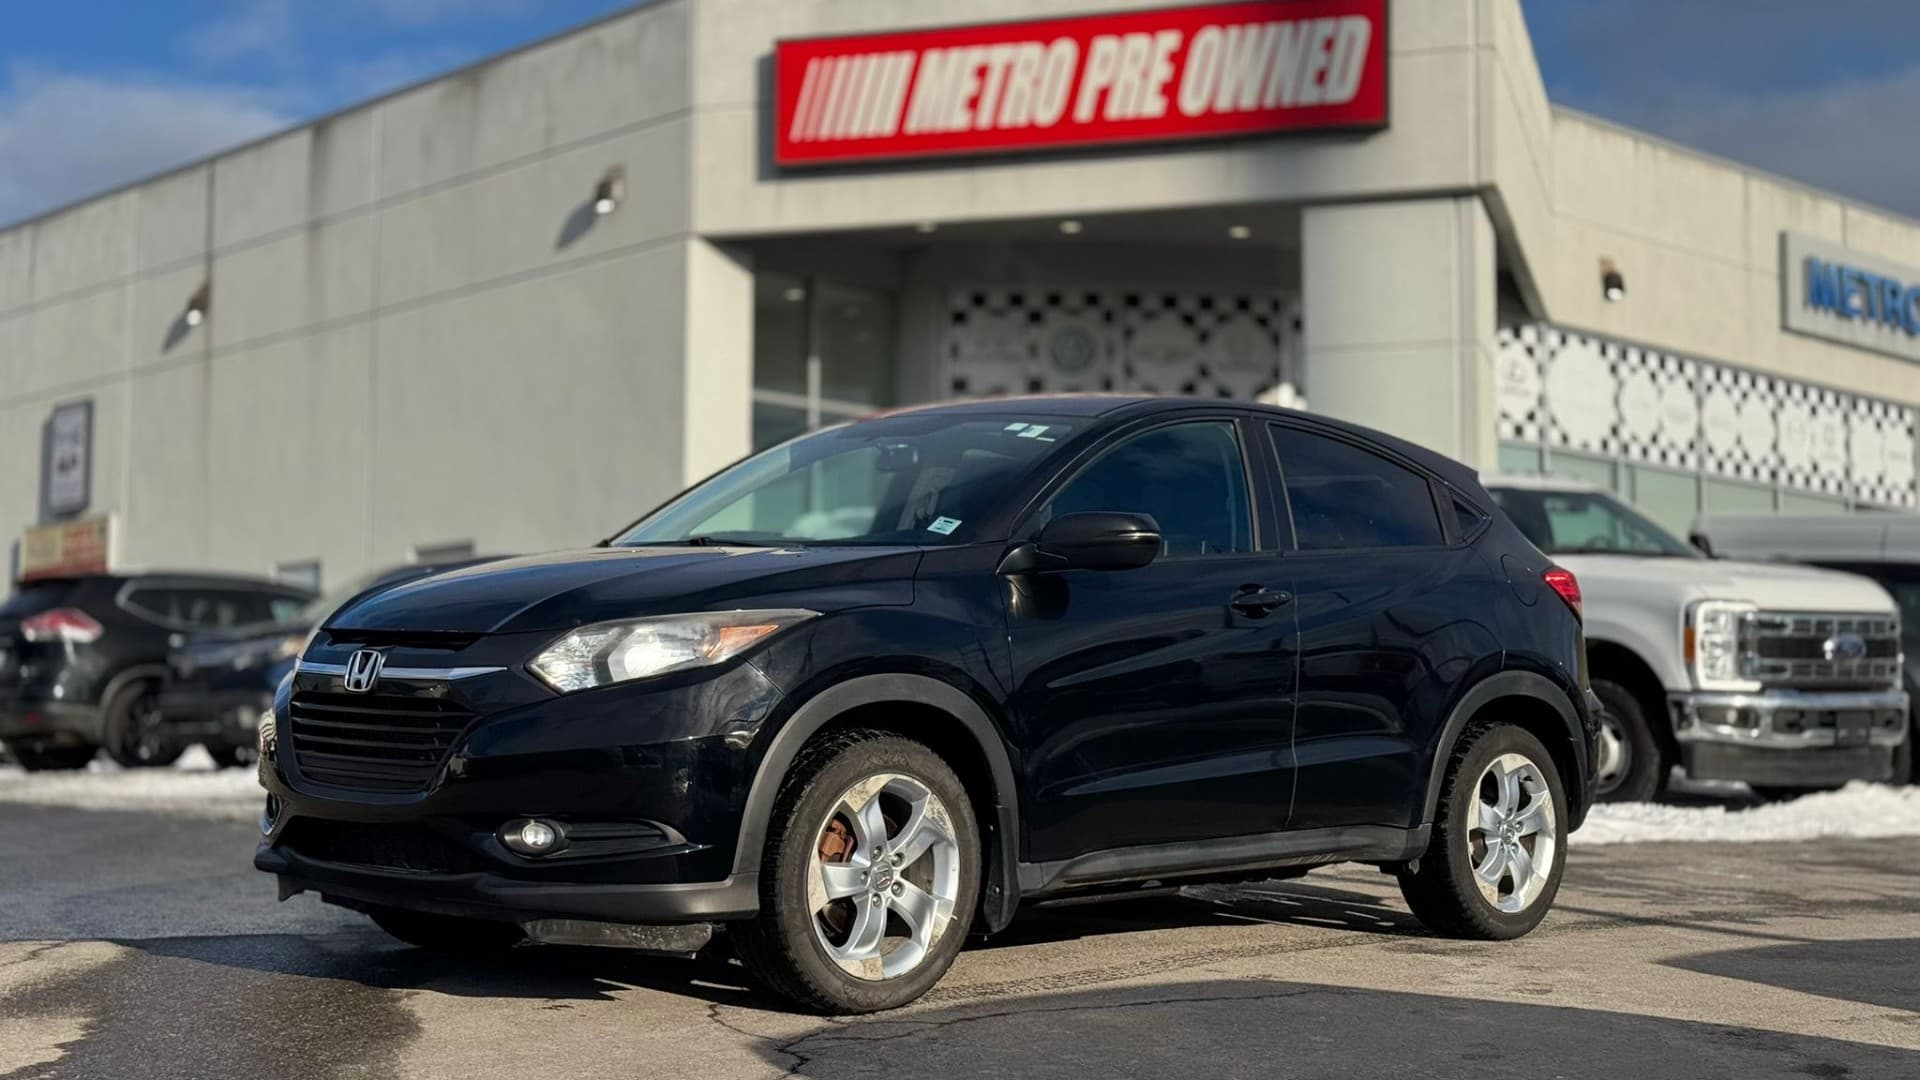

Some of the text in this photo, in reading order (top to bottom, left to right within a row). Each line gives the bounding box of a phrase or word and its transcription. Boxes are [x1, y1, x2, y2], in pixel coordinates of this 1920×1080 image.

[906, 17, 1369, 133] METRO PRE OWNED
